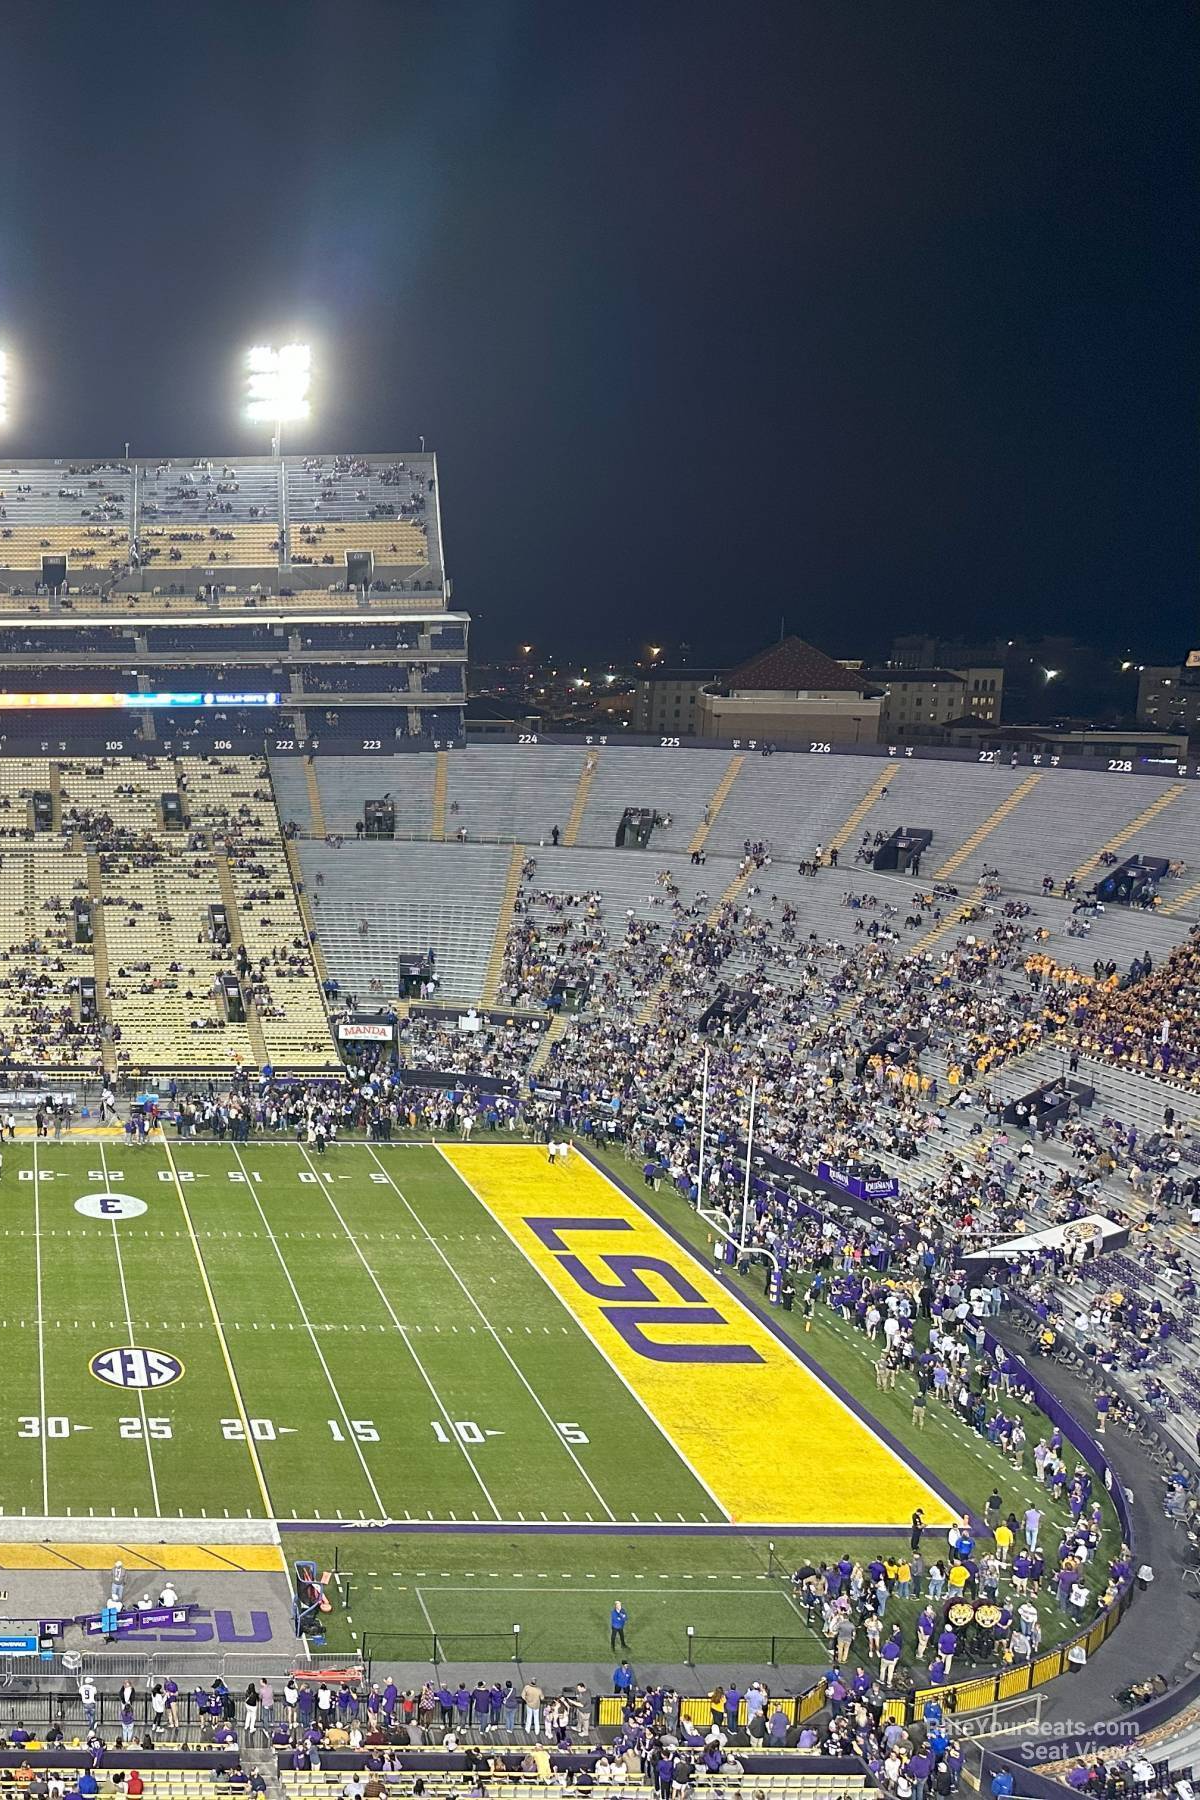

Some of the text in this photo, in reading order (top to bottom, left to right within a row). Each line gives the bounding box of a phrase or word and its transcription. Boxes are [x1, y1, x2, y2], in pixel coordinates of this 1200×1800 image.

[518, 734, 538, 744] 224
[660, 737, 681, 747] 225
[105, 741, 124, 751] 105
[214, 740, 233, 750] 106
[275, 740, 294, 750] 222
[362, 740, 382, 750] 223
[809, 742, 831, 753] 226
[978, 751, 995, 762] 22
[1107, 759, 1133, 772] 228
[344, 1026, 388, 1037] MANDA
[18, 1171, 55, 1181] 30
[87, 1171, 125, 1182] 25
[157, 1171, 196, 1182] 20
[227, 1171, 263, 1182] 15
[298, 1172, 334, 1183] 10
[368, 1173, 391, 1184] 5
[99, 1199, 123, 1214] 3
[522, 1216, 768, 1364] LSU
[97, 1349, 180, 1388] SEC
[17, 1416, 71, 1438] 30
[118, 1416, 173, 1439] 25
[221, 1418, 276, 1440] 20
[328, 1419, 381, 1442] 15
[430, 1421, 487, 1443] 10
[557, 1422, 590, 1444] 5
[82, 1687, 91, 1701] 9
